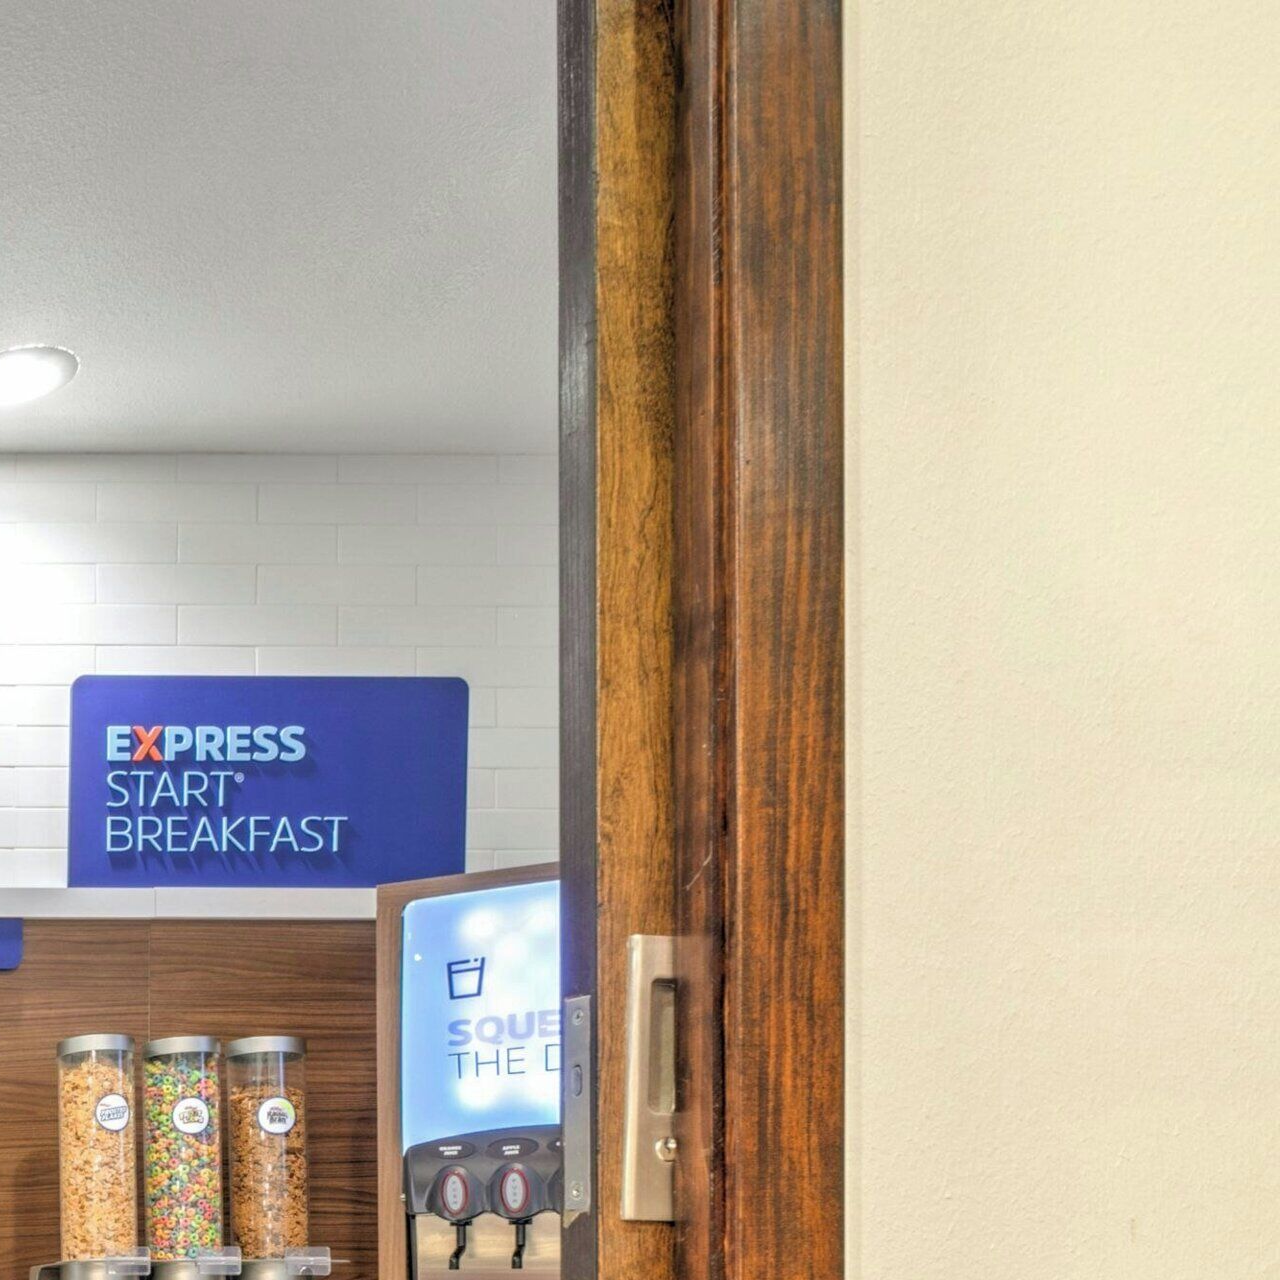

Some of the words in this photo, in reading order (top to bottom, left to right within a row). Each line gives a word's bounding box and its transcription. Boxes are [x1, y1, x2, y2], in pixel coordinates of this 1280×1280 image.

[106, 725, 307, 763] EXPRESS
[105, 816, 349, 853] BREAKFAST
[447, 1046, 526, 1079] THE
